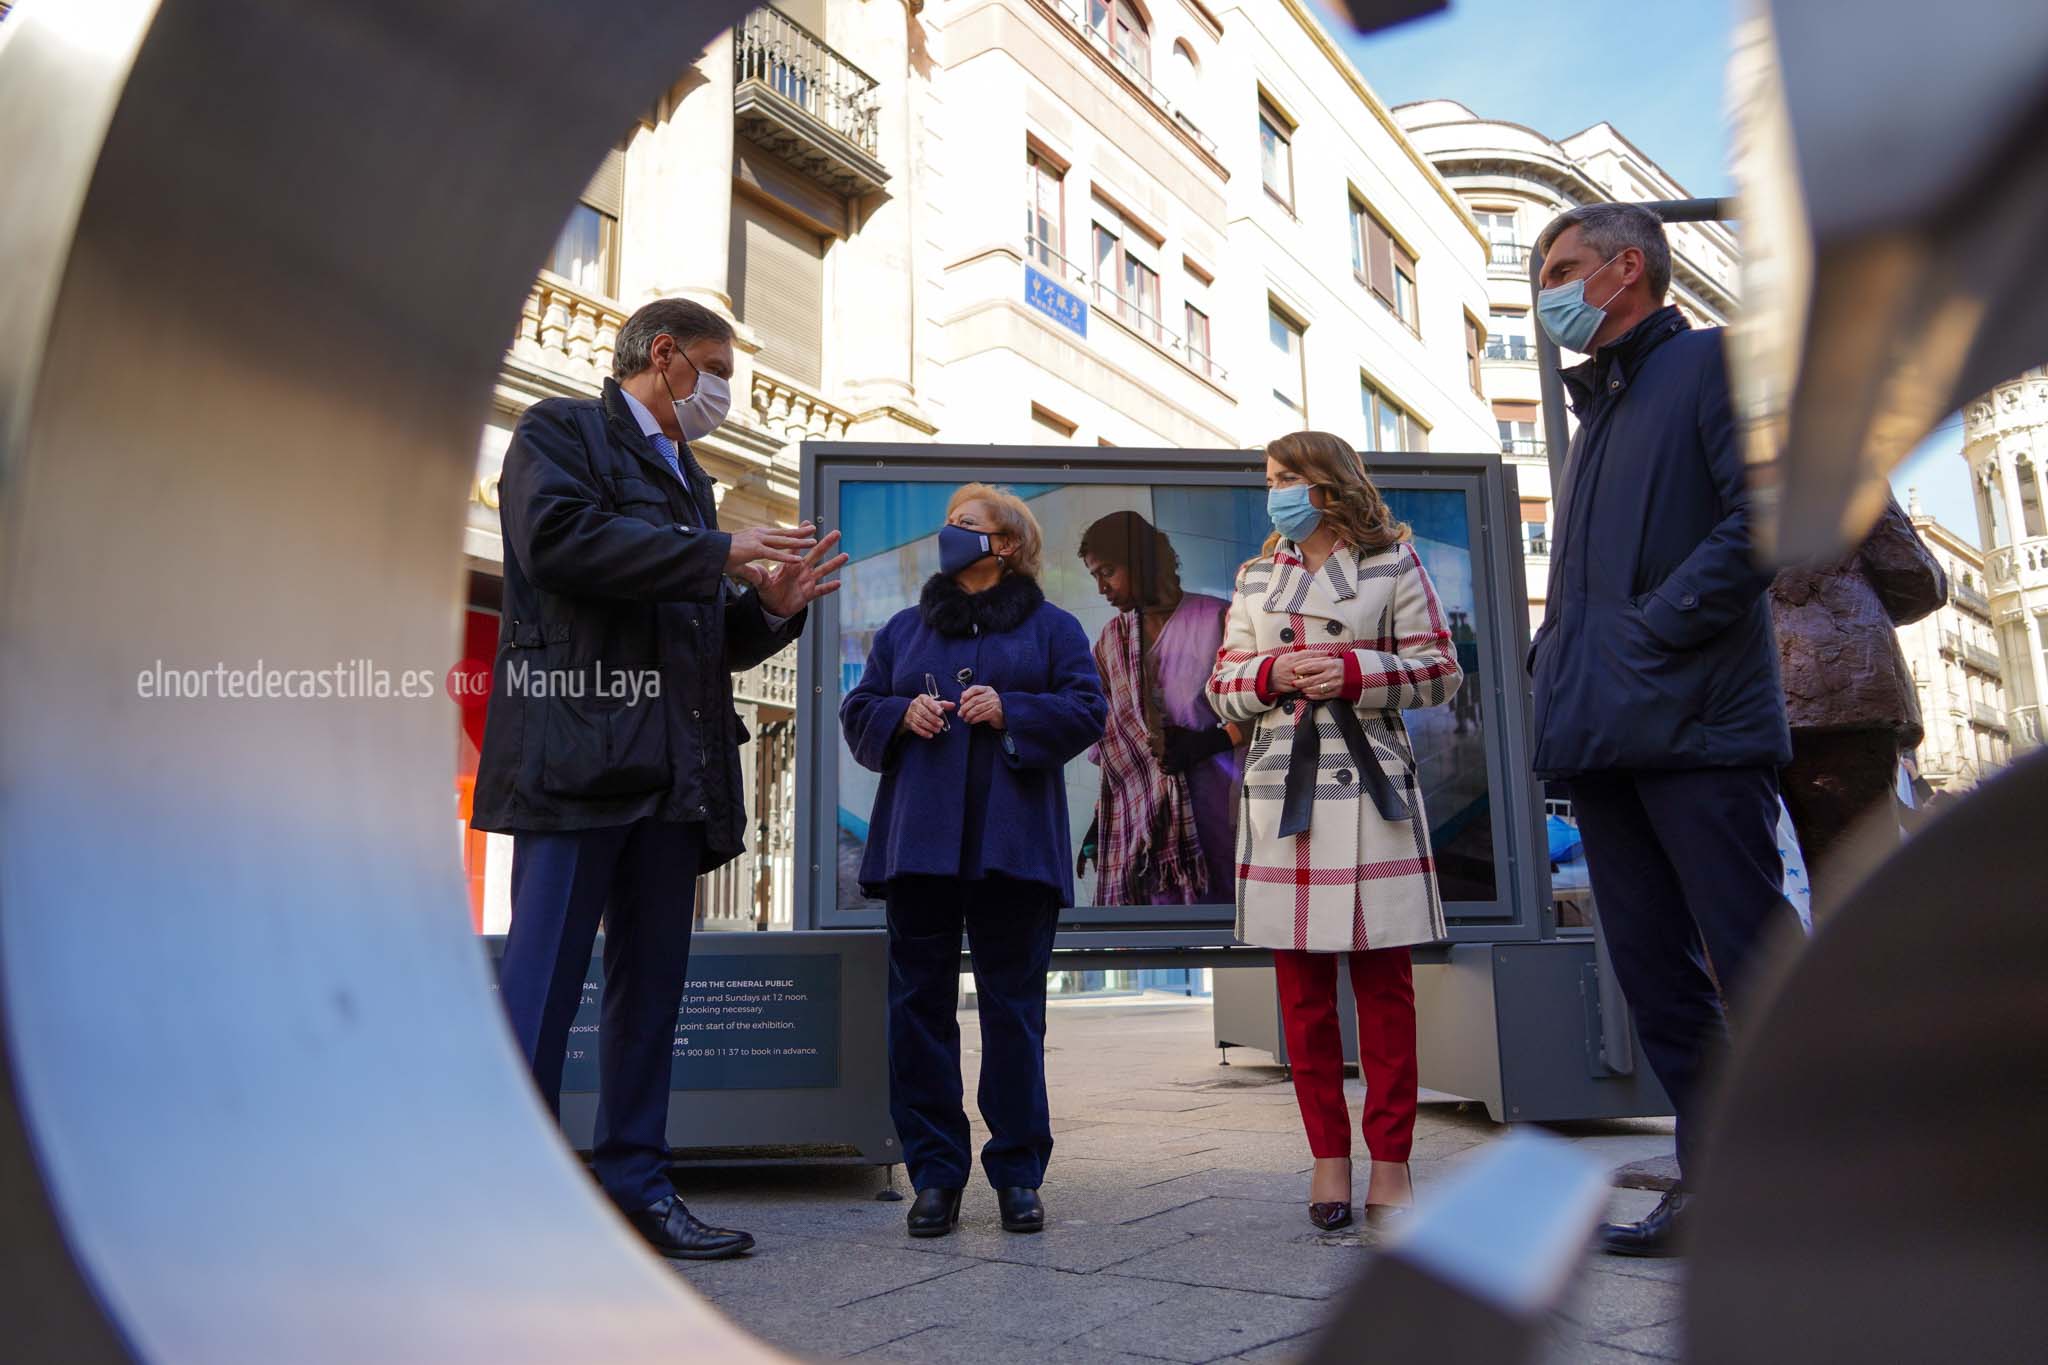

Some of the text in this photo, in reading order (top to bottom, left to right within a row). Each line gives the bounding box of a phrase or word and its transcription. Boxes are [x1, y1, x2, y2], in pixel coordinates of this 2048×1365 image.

[708, 980, 725, 988] THE
[726, 980, 764, 988] GENERAL
[765, 979, 794, 987] PUBLIC
[707, 994, 723, 1002] and
[725, 994, 760, 1003] Sundays
[773, 993, 783, 1001] 12
[686, 1006, 721, 1015] booking
[726, 1021, 735, 1029] of
[736, 1021, 750, 1029] the
[752, 1021, 795, 1030] exhibition.
[687, 1048, 703, 1057] 900
[704, 1048, 715, 1056] 80
[729, 1048, 739, 1056] 37
[741, 1047, 749, 1055] to
[751, 1046, 771, 1055] book
[773, 1046, 781, 1055] in
[782, 1046, 818, 1055] advance.
